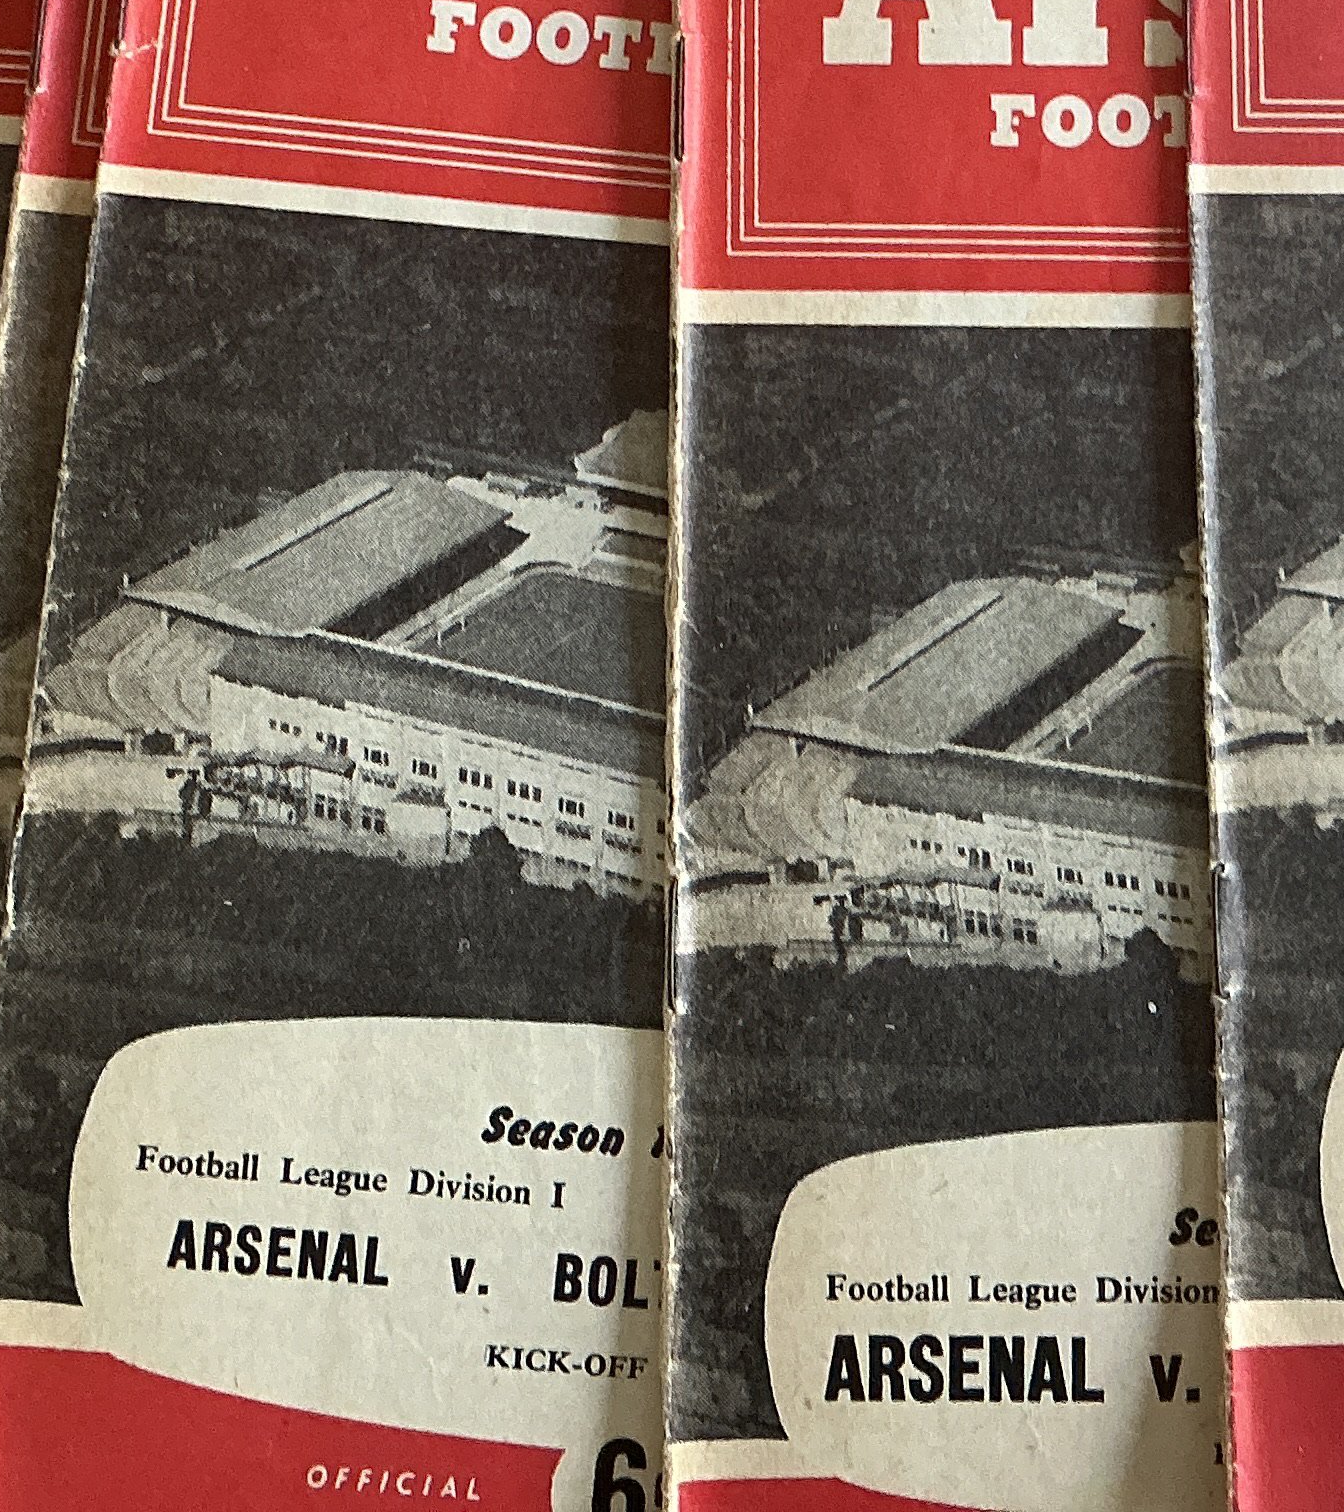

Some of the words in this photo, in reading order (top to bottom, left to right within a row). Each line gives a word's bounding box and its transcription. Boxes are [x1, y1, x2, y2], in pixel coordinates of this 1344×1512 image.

[480, 1105, 626, 1158] Season
[135, 1144, 260, 1183] Football
[280, 1156, 389, 1197] League
[408, 1167, 532, 1206] Division
[550, 1181, 567, 1209] I
[165, 1218, 390, 1288] ARSENAL
[450, 1256, 490, 1296] v.
[825, 1273, 950, 1303] Football
[967, 1274, 1078, 1311] League
[1095, 1274, 1219, 1305] Division
[484, 1343, 649, 1381] KICK-OFF
[824, 1333, 1106, 1404] ARSENAL
[1149, 1353, 1202, 1404] v.
[306, 1463, 482, 1502] OFFICIAL
